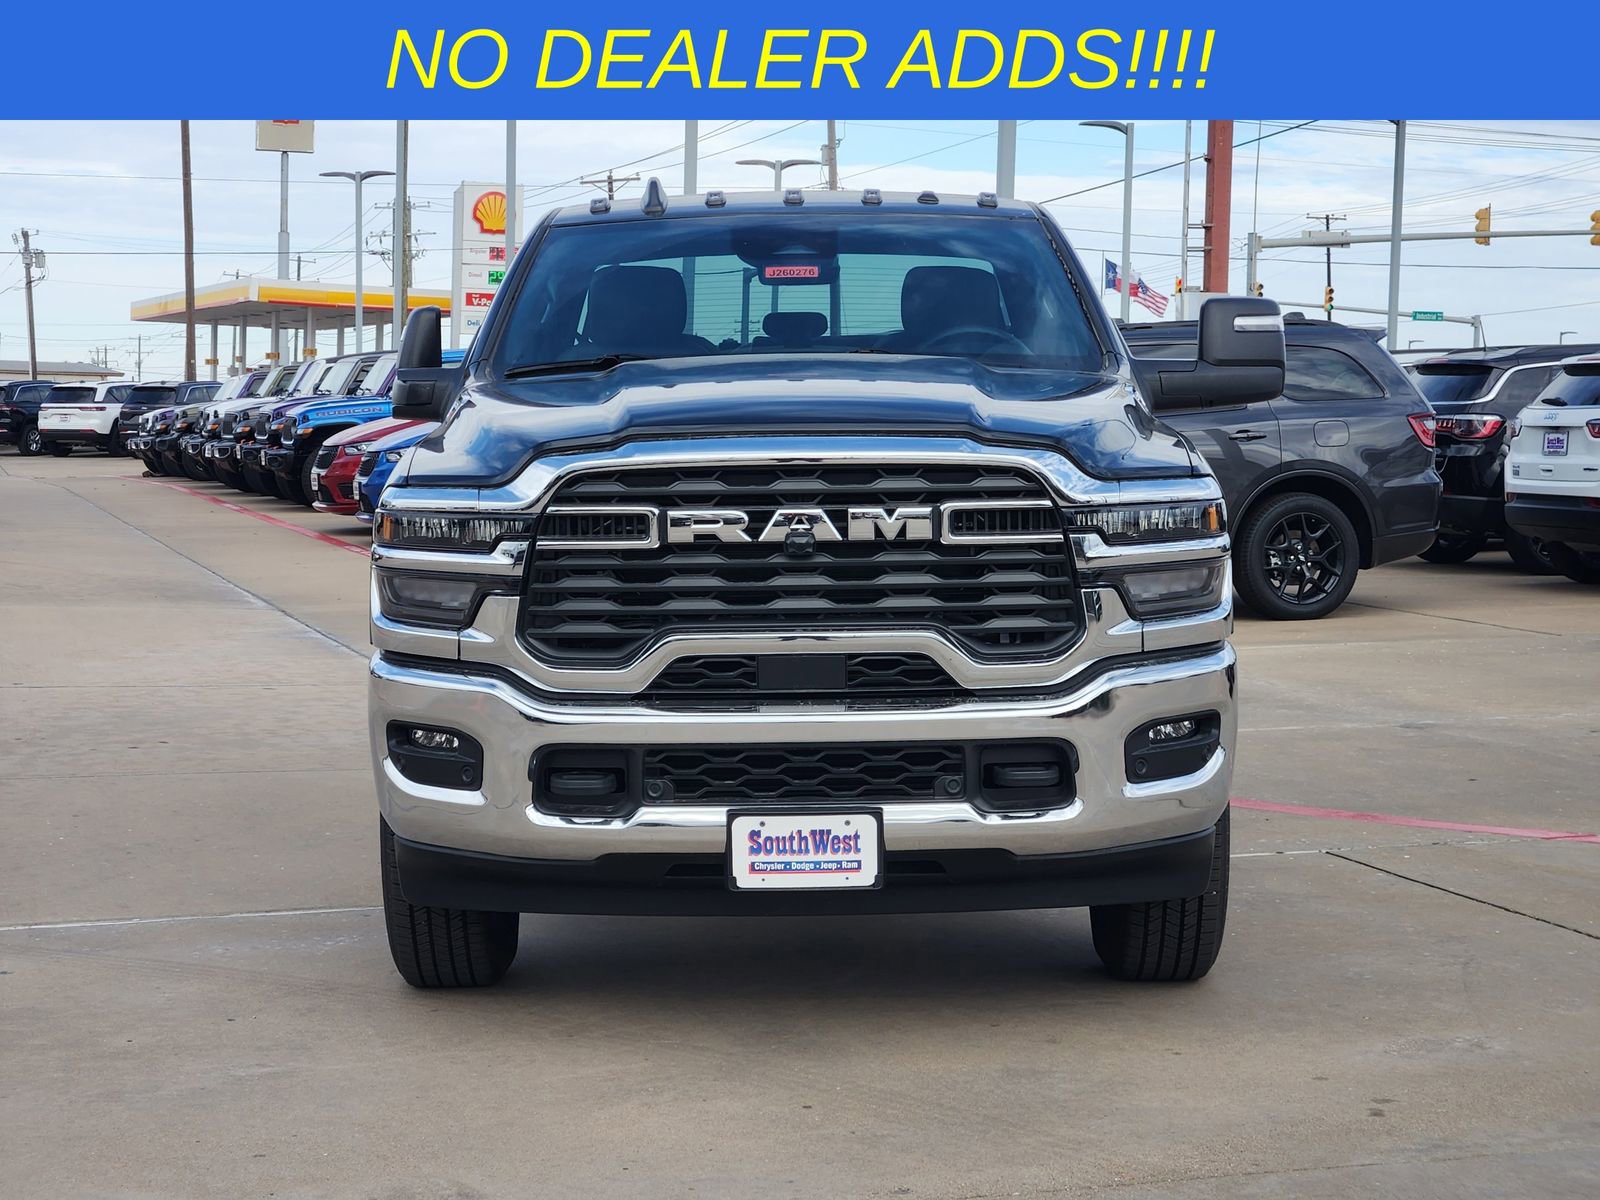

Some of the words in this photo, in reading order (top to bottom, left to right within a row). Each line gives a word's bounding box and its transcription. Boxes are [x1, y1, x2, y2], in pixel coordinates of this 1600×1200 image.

[769, 268, 815, 277] J260276
[315, 407, 383, 417] RUBICON
[667, 508, 933, 543] RAM
[748, 829, 861, 857] SouthWest
[754, 862, 785, 871] Chrysler
[791, 862, 815, 871] Dodge
[820, 861, 837, 871] Jeep
[842, 861, 858, 869] Ram
